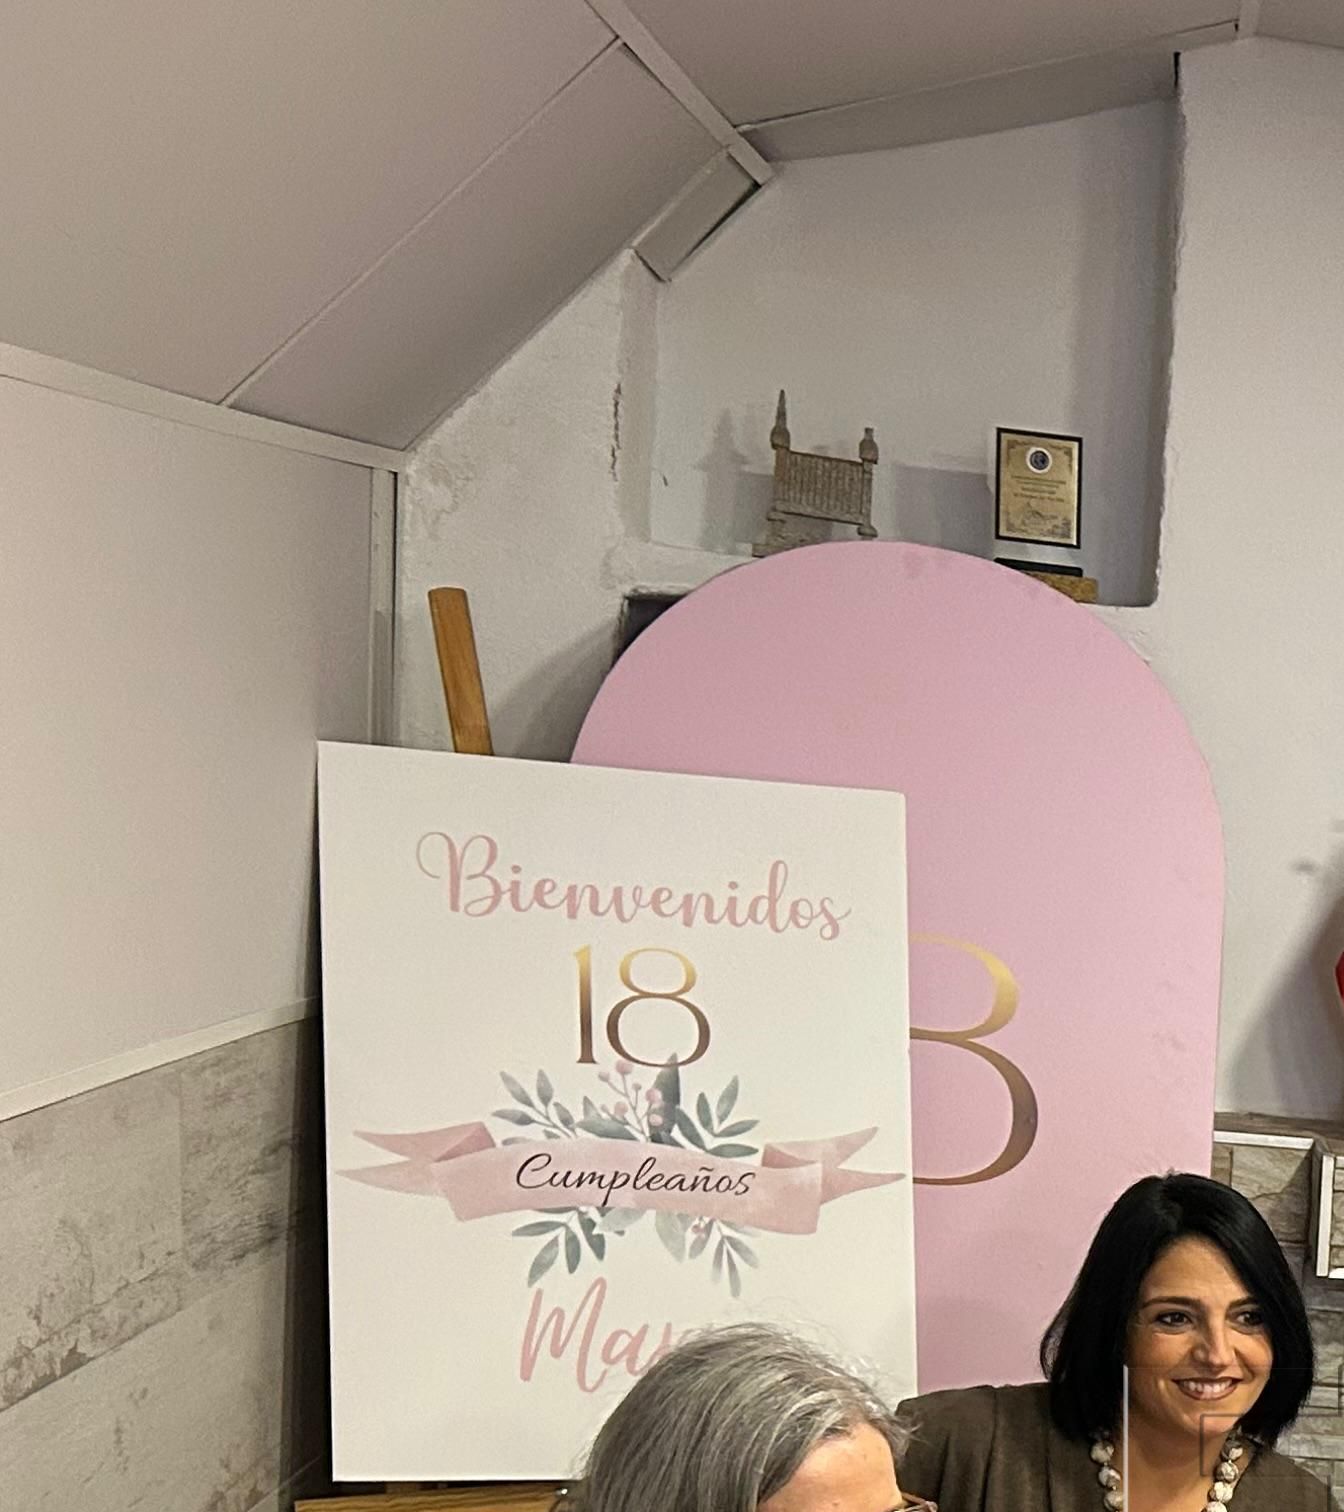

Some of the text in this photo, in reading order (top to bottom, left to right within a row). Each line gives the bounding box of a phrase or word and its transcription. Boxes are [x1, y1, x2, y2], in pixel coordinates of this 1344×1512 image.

[416, 832, 852, 941] Bienvenidos
[573, 944, 711, 1069] 18
[515, 1152, 758, 1205] Cumpleaños
